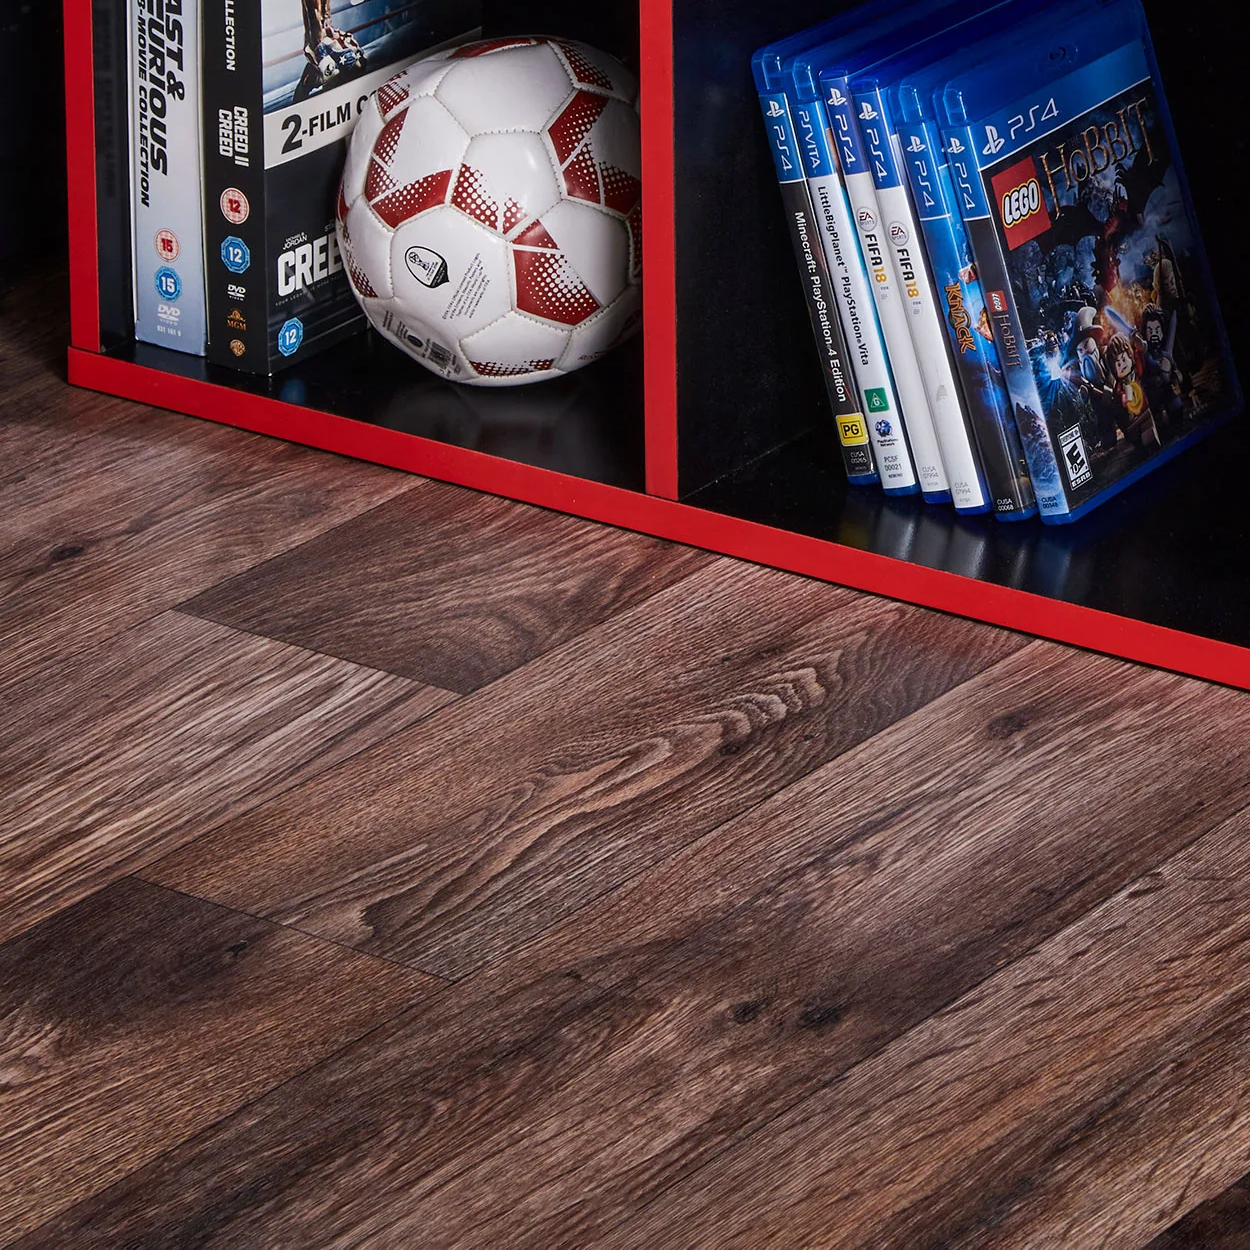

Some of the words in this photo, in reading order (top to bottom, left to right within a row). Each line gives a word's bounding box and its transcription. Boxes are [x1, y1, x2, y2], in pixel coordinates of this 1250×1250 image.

[166, 70, 185, 101] &
[218, 108, 233, 157] CREED
[233, 106, 249, 154] CREED
[281, 101, 351, 155] 2-FILM
[1008, 97, 1059, 140] PS4
[138, 84, 150, 208] COLLECTION
[773, 125, 793, 172] PS4
[835, 114, 856, 165] PS4
[866, 128, 888, 179] PS4
[914, 160, 935, 208] PS4
[955, 162, 976, 210] PS4
[228, 197, 241, 214] 12
[859, 211, 873, 221] EA
[1002, 179, 1041, 227] LEGO
[160, 236, 174, 253] 15
[891, 226, 905, 236] EA
[228, 246, 243, 264] 12
[277, 232, 343, 297] CREE
[160, 277, 175, 297] 15
[157, 303, 181, 317] DVD
[795, 211, 817, 273] Minecraft:
[830, 359, 847, 402] Edition
[944, 281, 977, 355] KNACK
[227, 320, 247, 331] MGM
[284, 329, 297, 346] 12
[842, 423, 860, 437] PG
[883, 455, 898, 463] PCSF
[884, 463, 903, 472] 00021
[1071, 471, 1091, 488] ESRB
